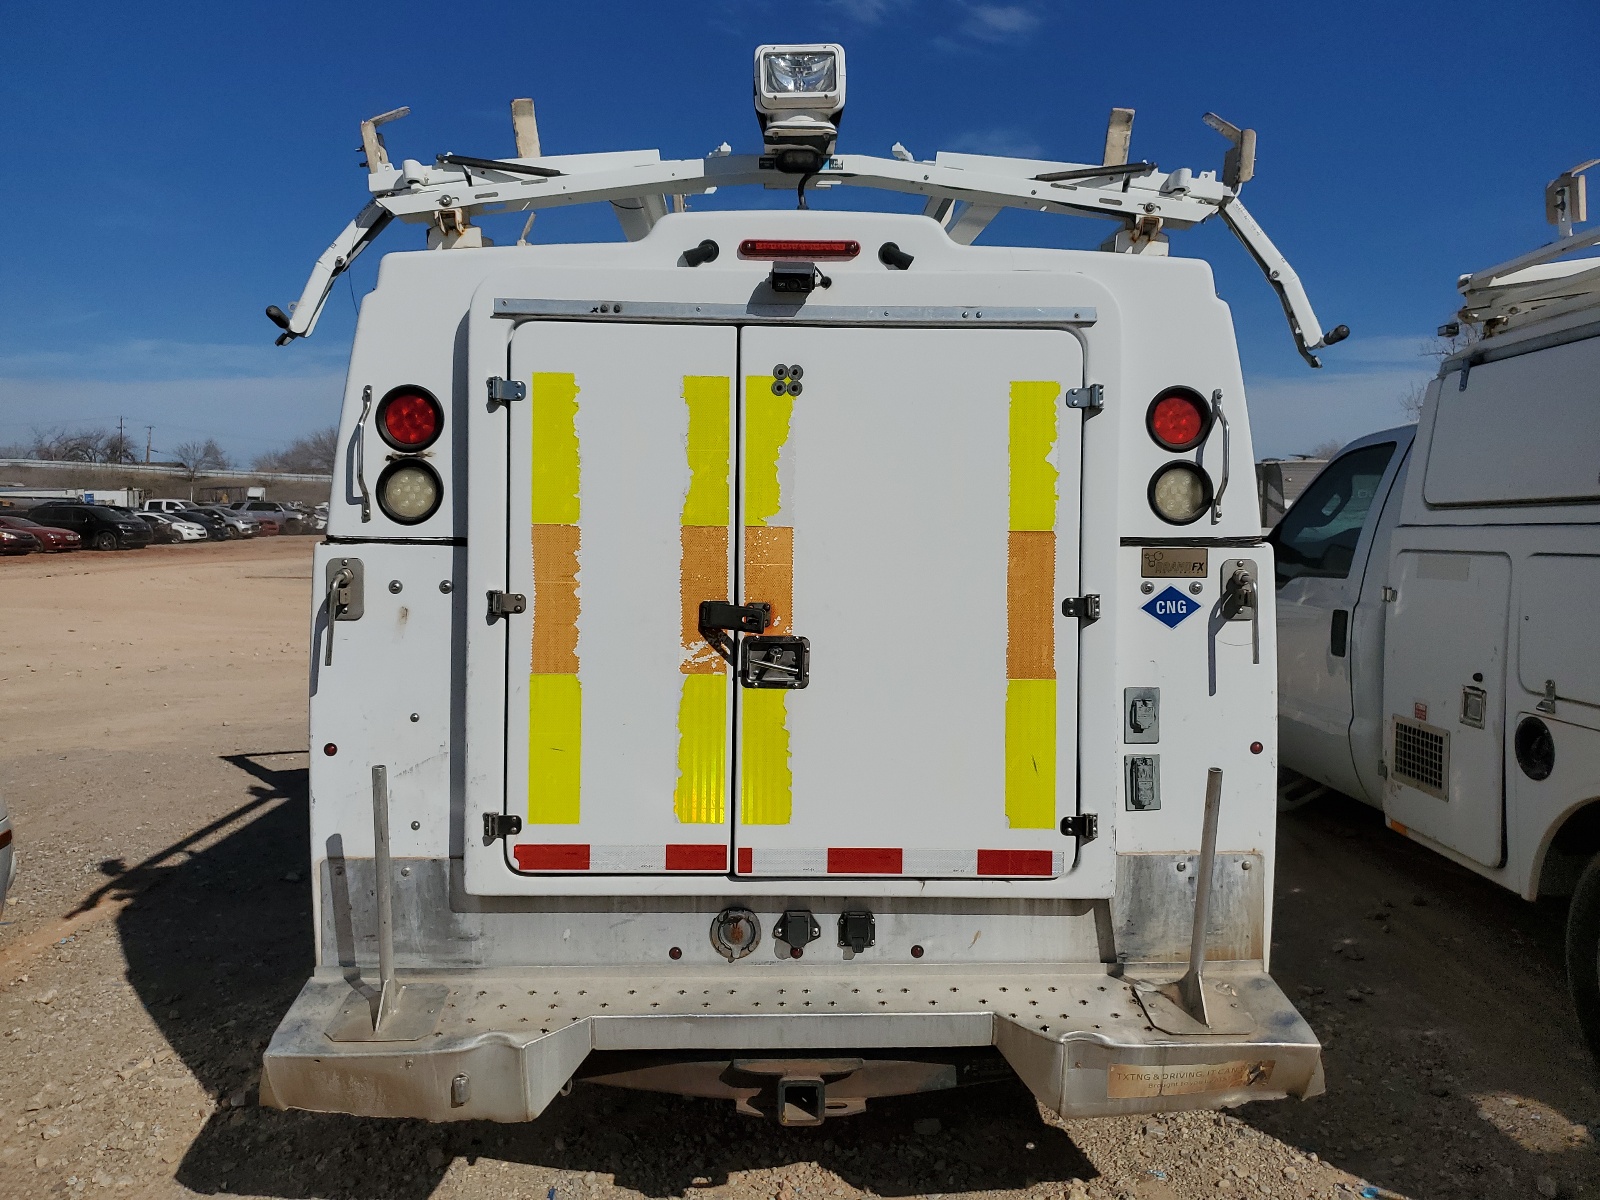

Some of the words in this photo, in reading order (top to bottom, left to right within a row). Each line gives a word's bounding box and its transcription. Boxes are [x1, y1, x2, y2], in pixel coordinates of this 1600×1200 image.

[1156, 600, 1187, 614] CNG
[1117, 1073, 1151, 1081] TXTNG
[1218, 1067, 1237, 1075] CAN
